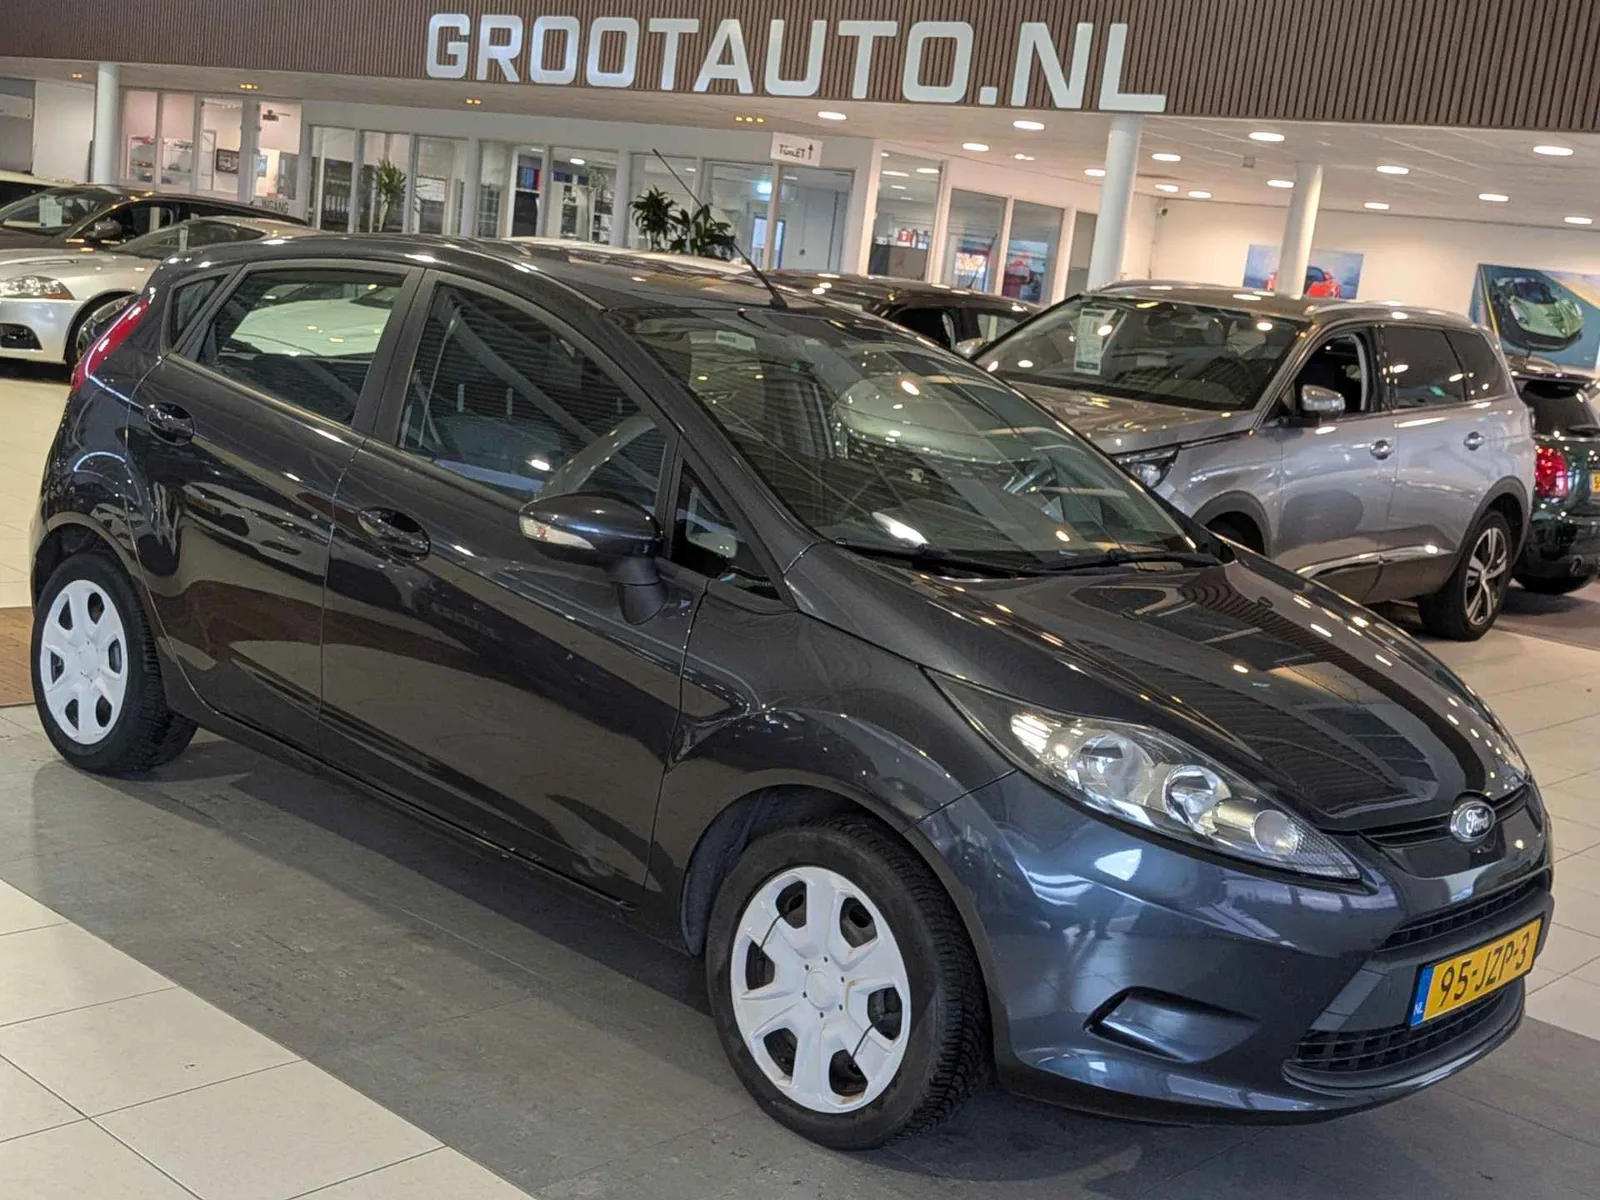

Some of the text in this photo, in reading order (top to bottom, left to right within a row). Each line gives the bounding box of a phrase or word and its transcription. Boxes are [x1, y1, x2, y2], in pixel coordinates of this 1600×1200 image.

[426, 13, 1167, 112] GROOTAUTO.NL
[1466, 809, 1489, 834] Ford
[1438, 931, 1531, 1008] 95-JZP-3
[1412, 1000, 1424, 1017] NL
